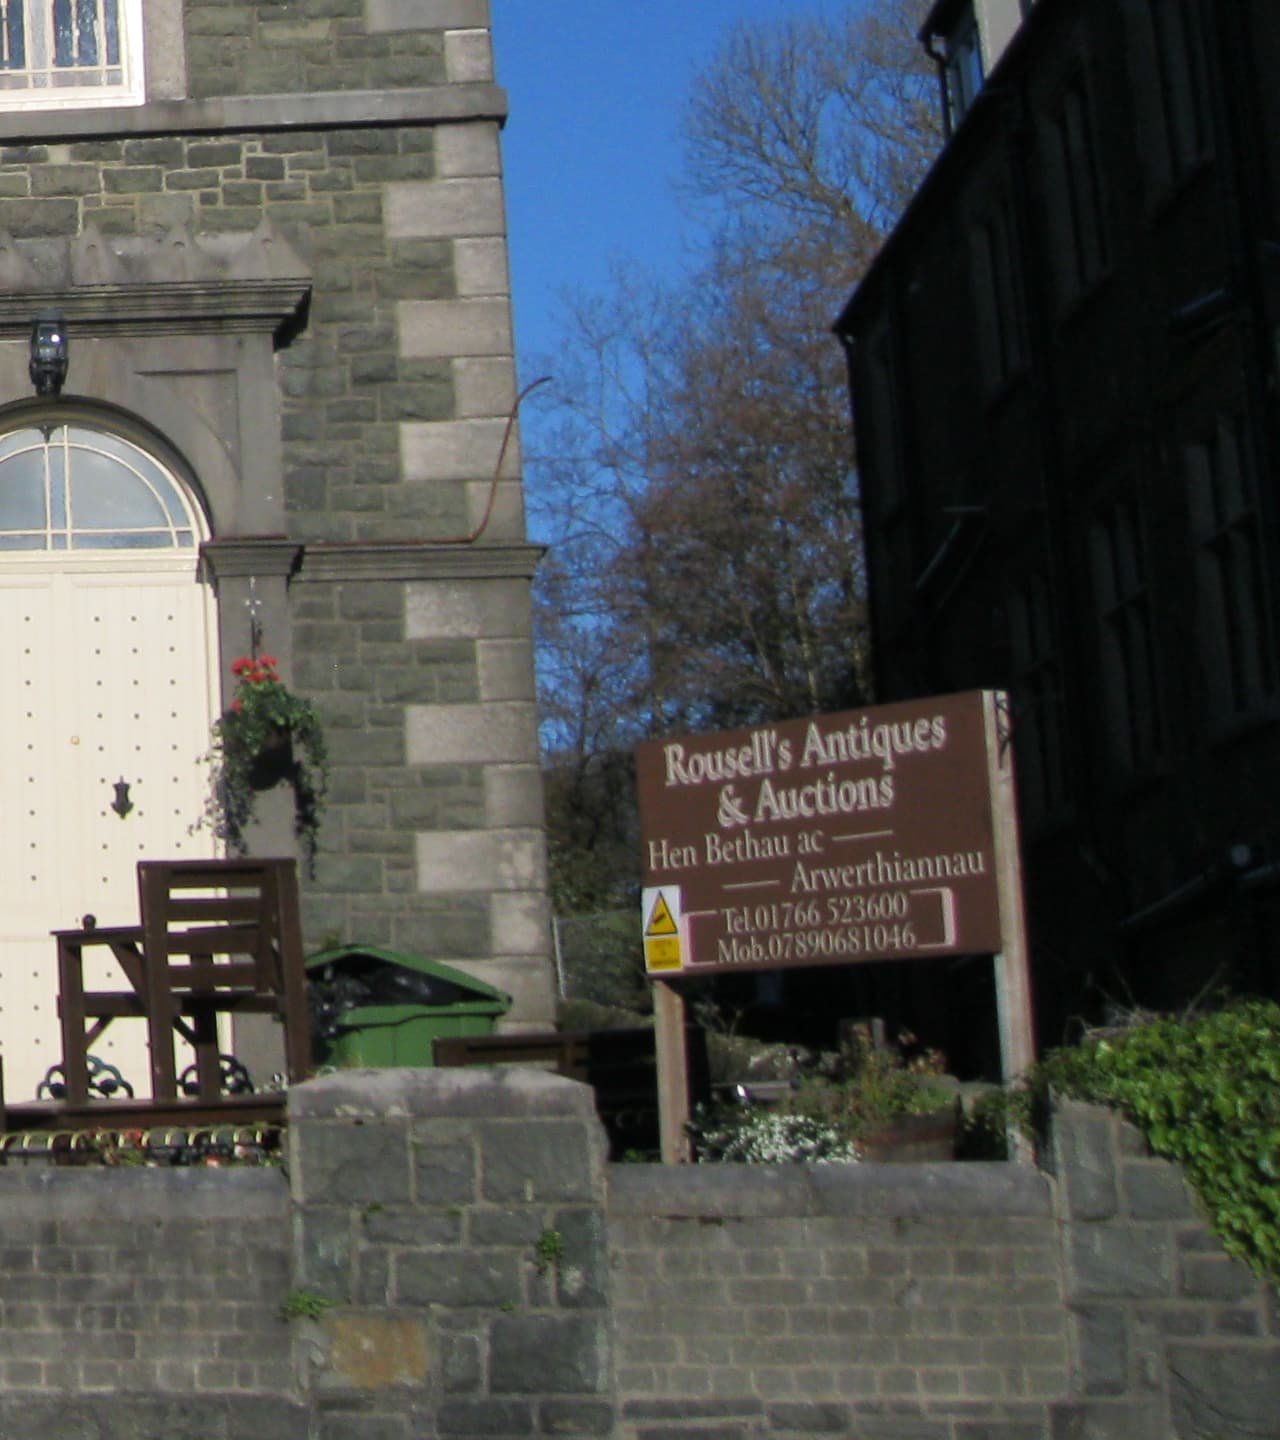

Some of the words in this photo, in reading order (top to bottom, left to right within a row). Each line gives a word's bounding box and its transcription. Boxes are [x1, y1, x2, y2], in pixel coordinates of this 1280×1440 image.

[664, 728, 793, 787] Rousell's
[799, 715, 947, 771] Antiques
[716, 783, 748, 828] &
[753, 771, 895, 823] Auctions
[647, 838, 697, 872] Hen
[704, 828, 790, 866] Bethau
[797, 830, 824, 854] ac
[790, 849, 987, 894] Arwerthiannau
[719, 900, 821, 934] Tel.01766
[827, 892, 909, 924] 523600
[717, 924, 918, 964] Mob.07890681046
